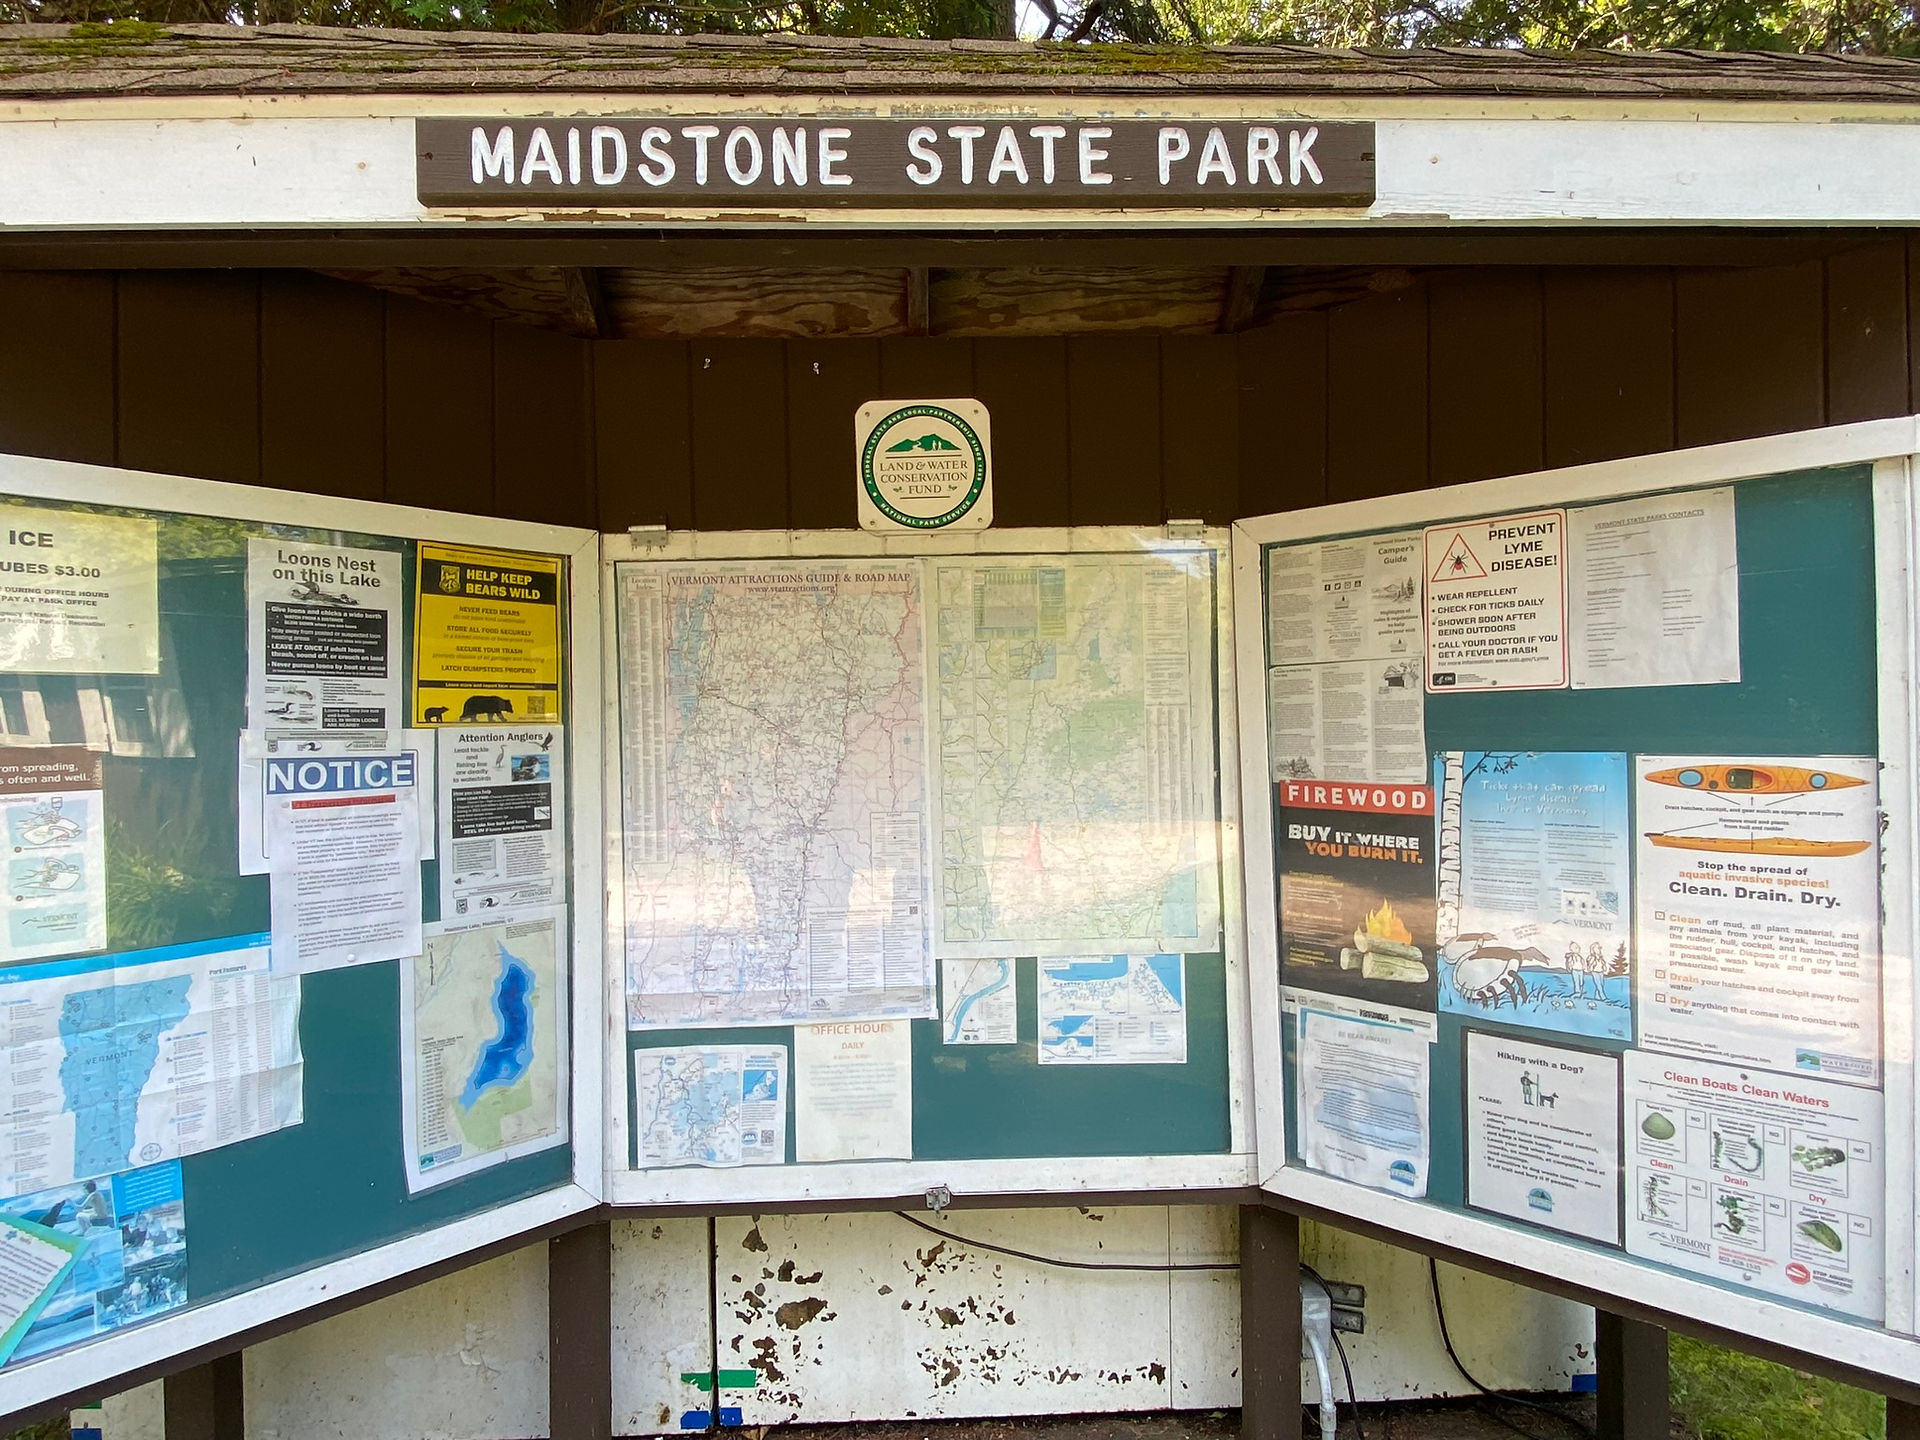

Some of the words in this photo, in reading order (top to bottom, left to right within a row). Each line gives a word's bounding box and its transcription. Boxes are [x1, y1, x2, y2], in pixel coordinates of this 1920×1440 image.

[470, 125, 854, 186] MAIDSTONE
[905, 125, 1113, 186] STATE
[1157, 125, 1324, 186] PARK
[865, 445, 873, 478] FEDERAL
[871, 423, 887, 443] STATE
[888, 414, 901, 425] AND
[902, 409, 926, 417] LOCAL
[929, 409, 973, 438] PARTNERSHIP
[880, 462, 913, 472] LAND
[915, 462, 925, 470] &
[927, 460, 968, 470] WATER
[880, 472, 968, 483] CONSERVATION
[908, 485, 942, 494] FUND
[881, 503, 916, 525] NATIONAL
[943, 501, 971, 523] SERVICE
[1594, 519, 1625, 530] VERMONT
[1627, 516, 1645, 525] STATE
[1646, 513, 1667, 522] PARKS
[1668, 509, 1705, 520] CONTACTS
[9, 530, 54, 548] ICE
[1488, 522, 1556, 541] PREVENT
[1378, 545, 1415, 556] Camper's
[1505, 541, 1543, 555] LYME
[277, 550, 331, 568] Loons
[337, 556, 376, 572] Nest
[1383, 555, 1408, 565] Guide
[1491, 555, 1558, 572] DISEASE!
[55, 565, 101, 578] $3.00
[272, 569, 295, 580] on
[300, 569, 334, 584] this
[340, 572, 381, 588] Lake
[466, 569, 498, 582] HELP
[500, 573, 533, 586] KEEP
[671, 575, 726, 586] VERMONT
[728, 574, 803, 584] ATTRACTIONS
[806, 574, 842, 583] GUIDE
[843, 574, 851, 582] &
[854, 573, 886, 582] ROAD
[888, 573, 910, 582] MAP
[5, 586, 41, 594] DURING
[465, 583, 507, 597] BEARS
[509, 587, 541, 600] WILD
[1437, 592, 1465, 602] WEAR
[1466, 587, 1518, 599] REPELLENT
[459, 606, 480, 614] NEVER
[481, 607, 498, 615] FEED
[500, 609, 520, 617] BEARS
[1437, 605, 1467, 614] CHECK
[1469, 603, 1486, 611] FOR
[1488, 601, 1515, 610] TICKS
[1517, 598, 1545, 607] DAILY
[1437, 617, 1477, 627] SHOWER
[1478, 615, 1504, 624] SOON
[1506, 612, 1536, 622] AFTER
[447, 625, 467, 633] STORE
[482, 627, 499, 635] FOOD
[500, 628, 532, 636] SECURELY
[1438, 627, 1465, 637] BEING
[1466, 624, 1516, 635] OUTDOORS
[1438, 640, 1460, 649] CALL
[1462, 639, 1487, 648] YOUR
[1488, 637, 1526, 646] DOCTOR
[1528, 636, 1536, 644] IF
[1538, 634, 1558, 643] YOU
[456, 645, 482, 653] SECURE
[483, 646, 500, 654] YOUR
[1438, 650, 1456, 659] GET
[1457, 650, 1463, 658] A
[1466, 649, 1495, 657] FEVER
[1512, 646, 1538, 655] RASH
[441, 664, 462, 672] LATCH
[463, 665, 503, 673] DUMPSTERS
[459, 733, 505, 743] Attention
[507, 731, 544, 742] Anglers
[23, 762, 79, 773] spreading.
[8, 774, 38, 785] often
[41, 775, 61, 783] and
[64, 772, 90, 783] well.
[268, 759, 414, 792] NOTICE
[1481, 780, 1508, 792] Ticks
[1545, 783, 1564, 792] can
[1288, 784, 1427, 810] FIREWOOD
[1288, 823, 1331, 842] BUY
[1335, 831, 1351, 844] IT
[1356, 832, 1420, 850] WHERE
[1305, 841, 1343, 858] YOU
[1348, 844, 1397, 861] BURN
[1401, 849, 1423, 864] IT.
[1697, 861, 1724, 872] Stop
[1728, 862, 1746, 872] the
[1750, 865, 1791, 875] spread
[1795, 867, 1808, 876] of
[1679, 870, 1721, 881] aquatic
[1725, 872, 1774, 884] invasive
[1776, 877, 1829, 890] species!
[1669, 881, 1728, 898] Clean.
[1734, 886, 1793, 903] Drain.
[1801, 891, 1841, 909] Dry.
[1573, 919, 1613, 931] VERMONT
[1669, 914, 1701, 925] Clean
[1707, 919, 1719, 927] off
[1723, 920, 1745, 930] mud,
[1750, 922, 1761, 930] all
[1766, 925, 1790, 934] plant
[1794, 927, 1834, 938] material,
[1841, 931, 1859, 940] and
[1669, 925, 1684, 934] any
[1689, 926, 1722, 936] animals
[1727, 929, 1748, 938] from
[1753, 932, 1774, 941] your
[1779, 935, 1809, 945] kayak,
[1814, 938, 1859, 950] including
[1670, 996, 1689, 1007] Dry
[1691, 999, 1729, 1012] anything
[1730, 1005, 1748, 1015] that
[812, 1024, 850, 1035] OFFICE
[85, 1050, 134, 1065] VERMONT
[1497, 1051, 1526, 1065] Hiking
[1528, 1057, 1549, 1068] with
[1560, 1063, 1584, 1074] Dog?
[1664, 1070, 1699, 1086] Clean
[1702, 1077, 1739, 1092] Boats
[1741, 1084, 1780, 1100] Clean
[1782, 1090, 1830, 1108] Waters
[1769, 1130, 1780, 1138] NO
[1650, 1158, 1674, 1171] Clean
[1723, 1175, 1749, 1187] Drain
[1769, 1202, 1780, 1210] NO
[1808, 1193, 1827, 1205] Dry
[1670, 1233, 1711, 1252] VERMONT
